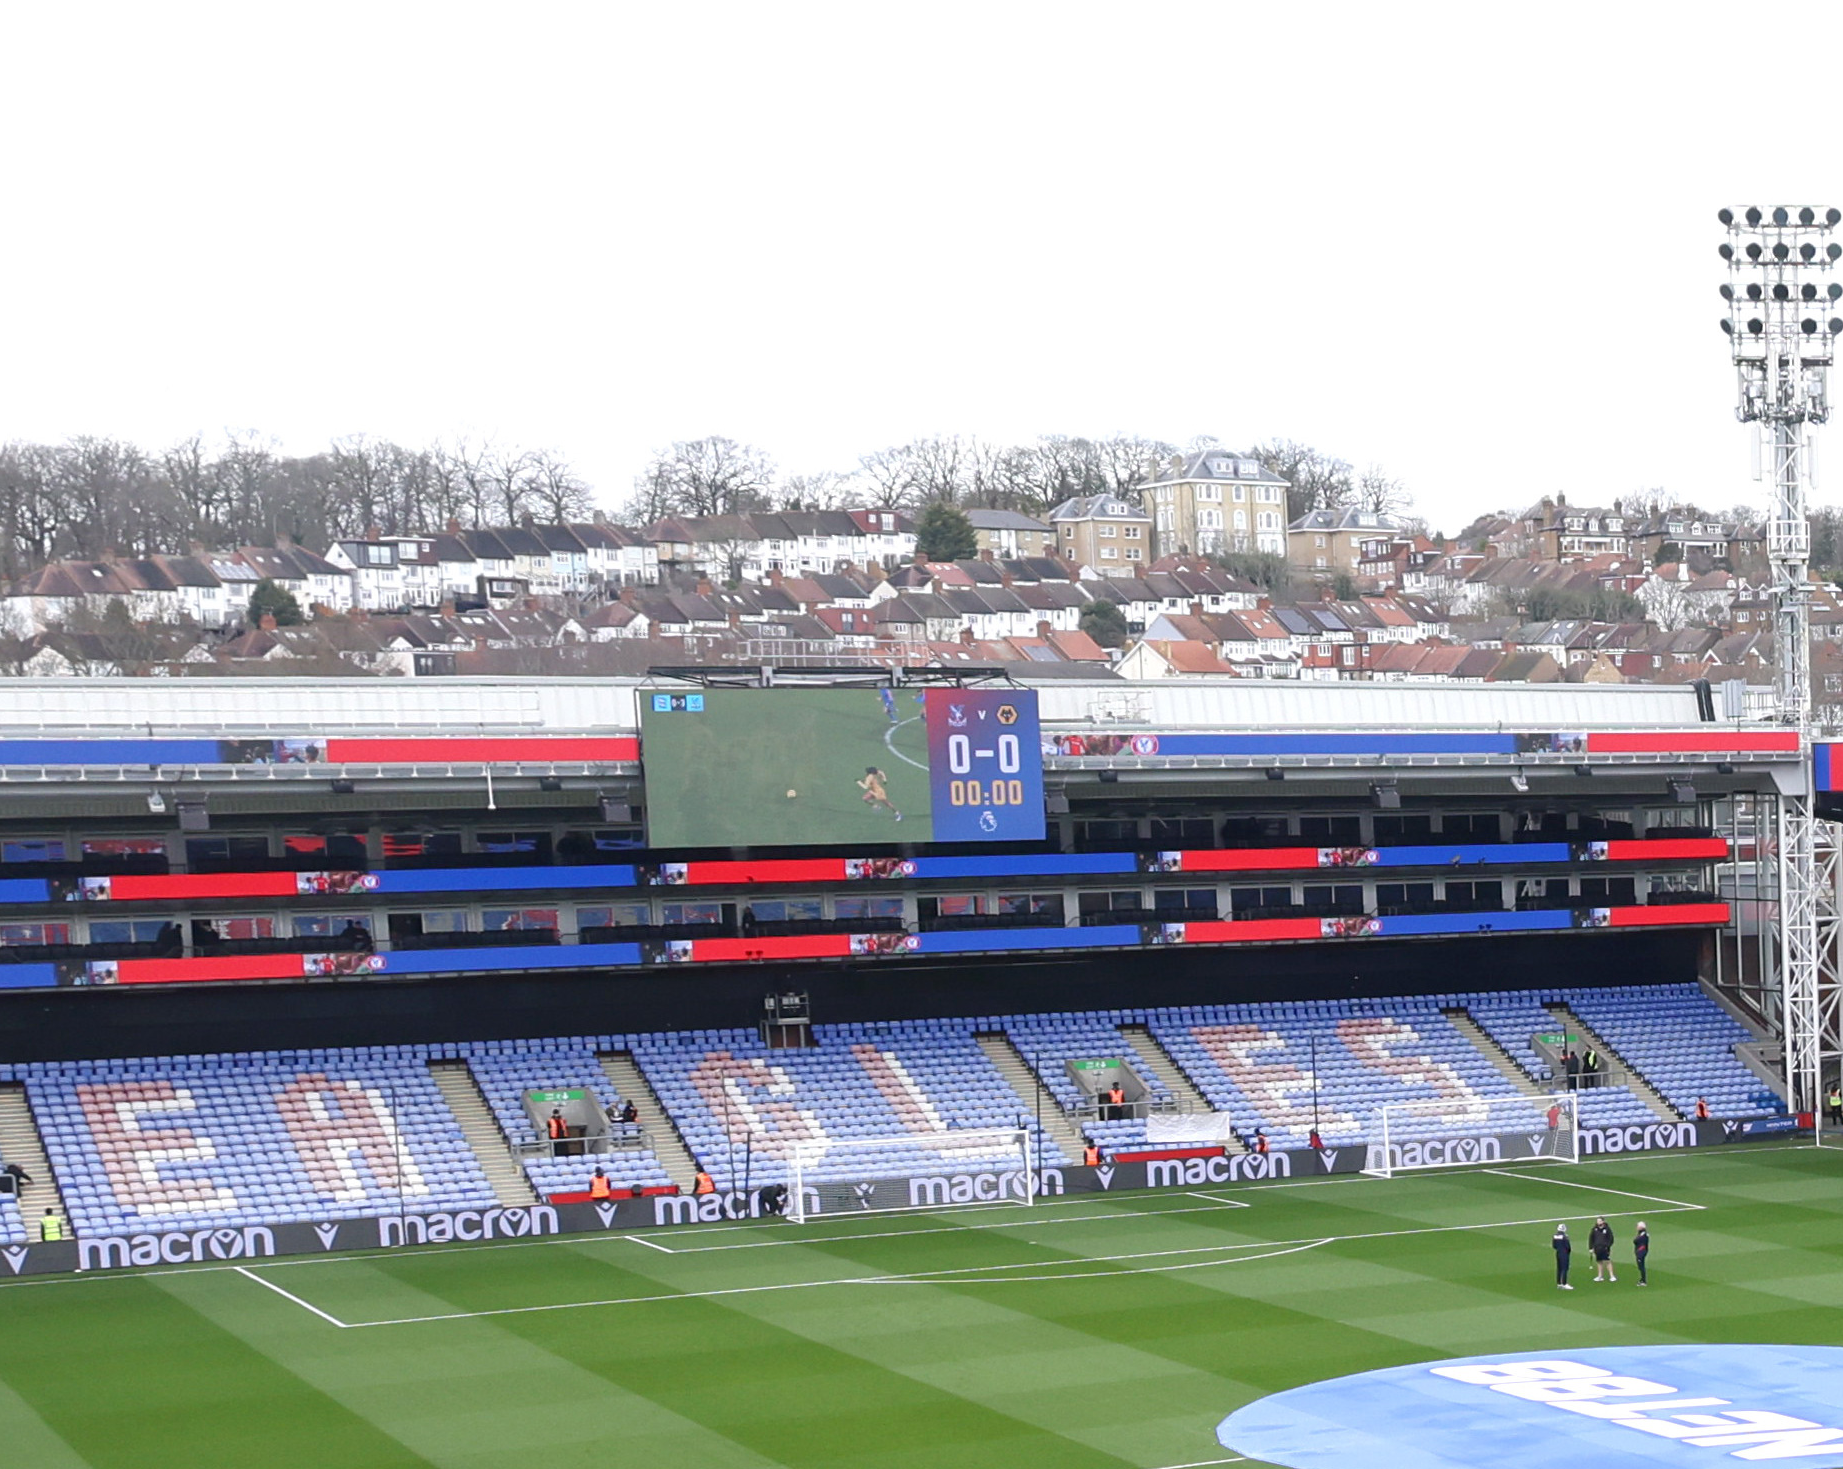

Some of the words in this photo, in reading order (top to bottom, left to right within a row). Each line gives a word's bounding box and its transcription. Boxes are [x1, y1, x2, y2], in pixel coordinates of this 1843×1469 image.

[949, 734, 1020, 774] 0-0
[951, 780, 1022, 806] 00:00
[1374, 1137, 1500, 1167] macron
[1578, 1123, 1697, 1154] macron
[910, 1169, 1063, 1204] macron
[1147, 1151, 1291, 1188] macron
[378, 1205, 559, 1247] macron
[79, 1225, 275, 1270] macron
